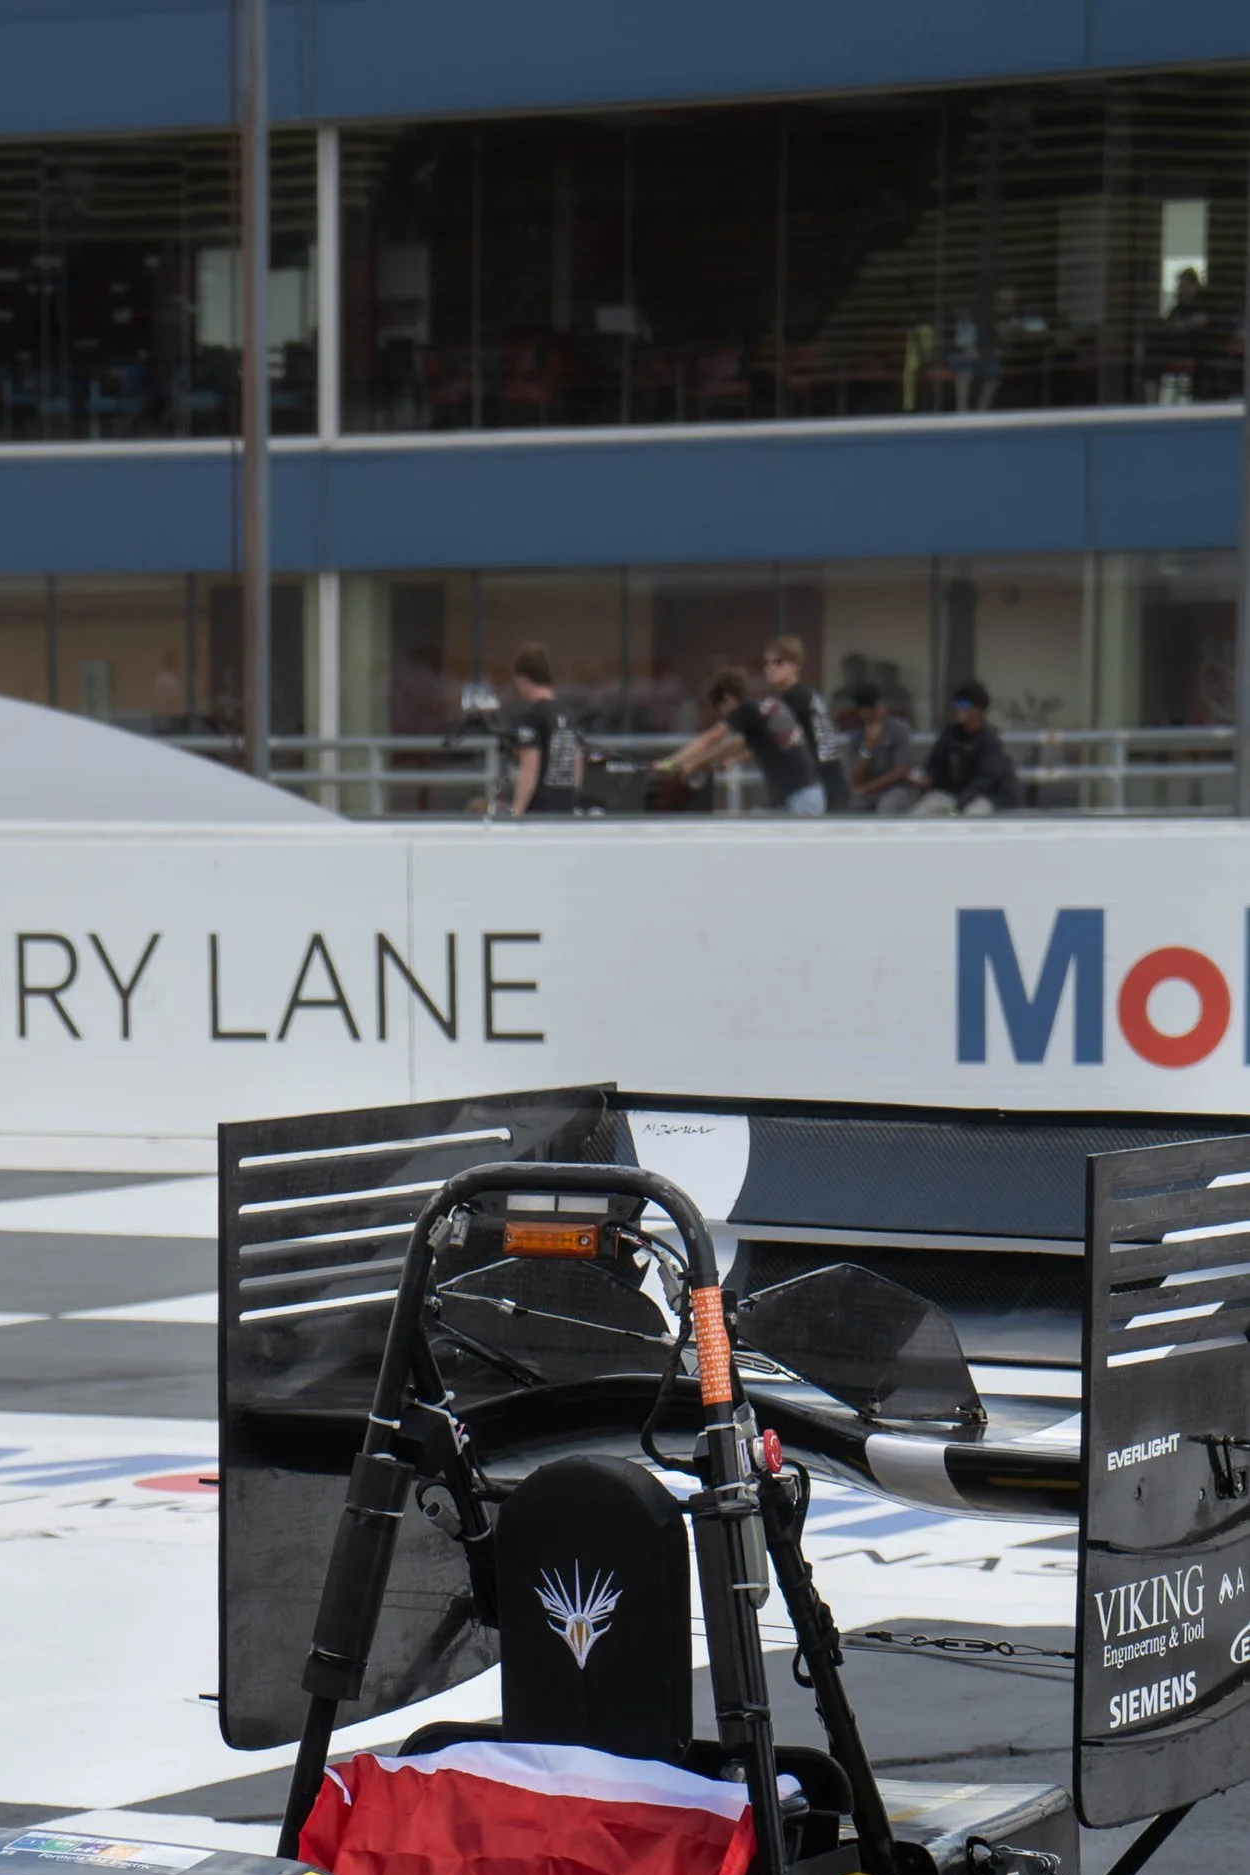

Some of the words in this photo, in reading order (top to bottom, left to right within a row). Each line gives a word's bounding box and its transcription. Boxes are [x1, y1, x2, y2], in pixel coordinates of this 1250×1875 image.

[208, 931, 546, 1044] LANE
[956, 907, 1250, 1070] Mo
[1107, 1432, 1181, 1472] EVERLIGHT
[1094, 1563, 1206, 1642] VIKING
[1102, 1633, 1168, 1670] Engineering
[1168, 1625, 1180, 1650] &
[1181, 1616, 1206, 1644] Tool
[1109, 1669, 1198, 1730] SIEMENS
